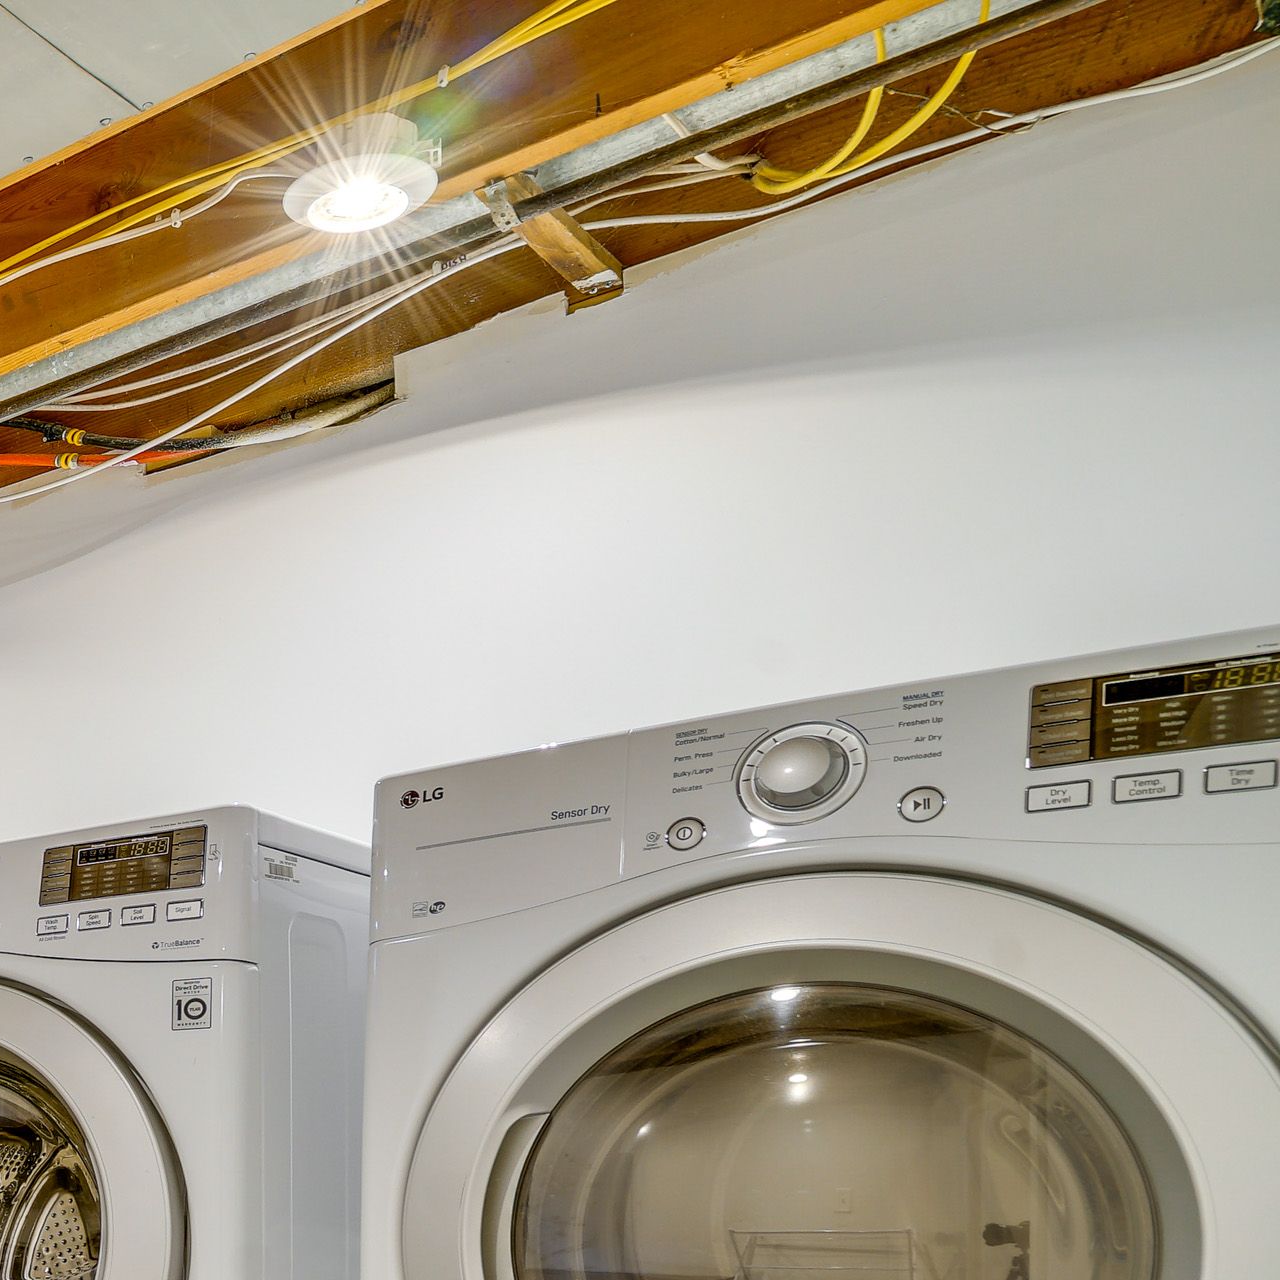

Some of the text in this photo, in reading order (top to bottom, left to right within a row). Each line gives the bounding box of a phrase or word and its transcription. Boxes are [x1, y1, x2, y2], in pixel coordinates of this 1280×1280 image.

[902, 690, 944, 701] MANUAL DRY
[903, 699, 944, 710] Speed Dry
[898, 719, 930, 728] Freshen
[675, 733, 725, 746] Cotton/Normal
[694, 751, 713, 759] Press
[893, 751, 942, 762] Downloaded
[673, 766, 713, 778] Bulky/Large
[1229, 768, 1255, 776] Time
[1231, 777, 1250, 786] Dry
[672, 784, 703, 793] Delicates
[1050, 788, 1067, 797] Dry
[1129, 786, 1166, 796] Control
[423, 787, 444, 803] LG
[1045, 796, 1072, 805] Level
[551, 804, 611, 821] Sensor Dry
[176, 998, 207, 1020] 10
